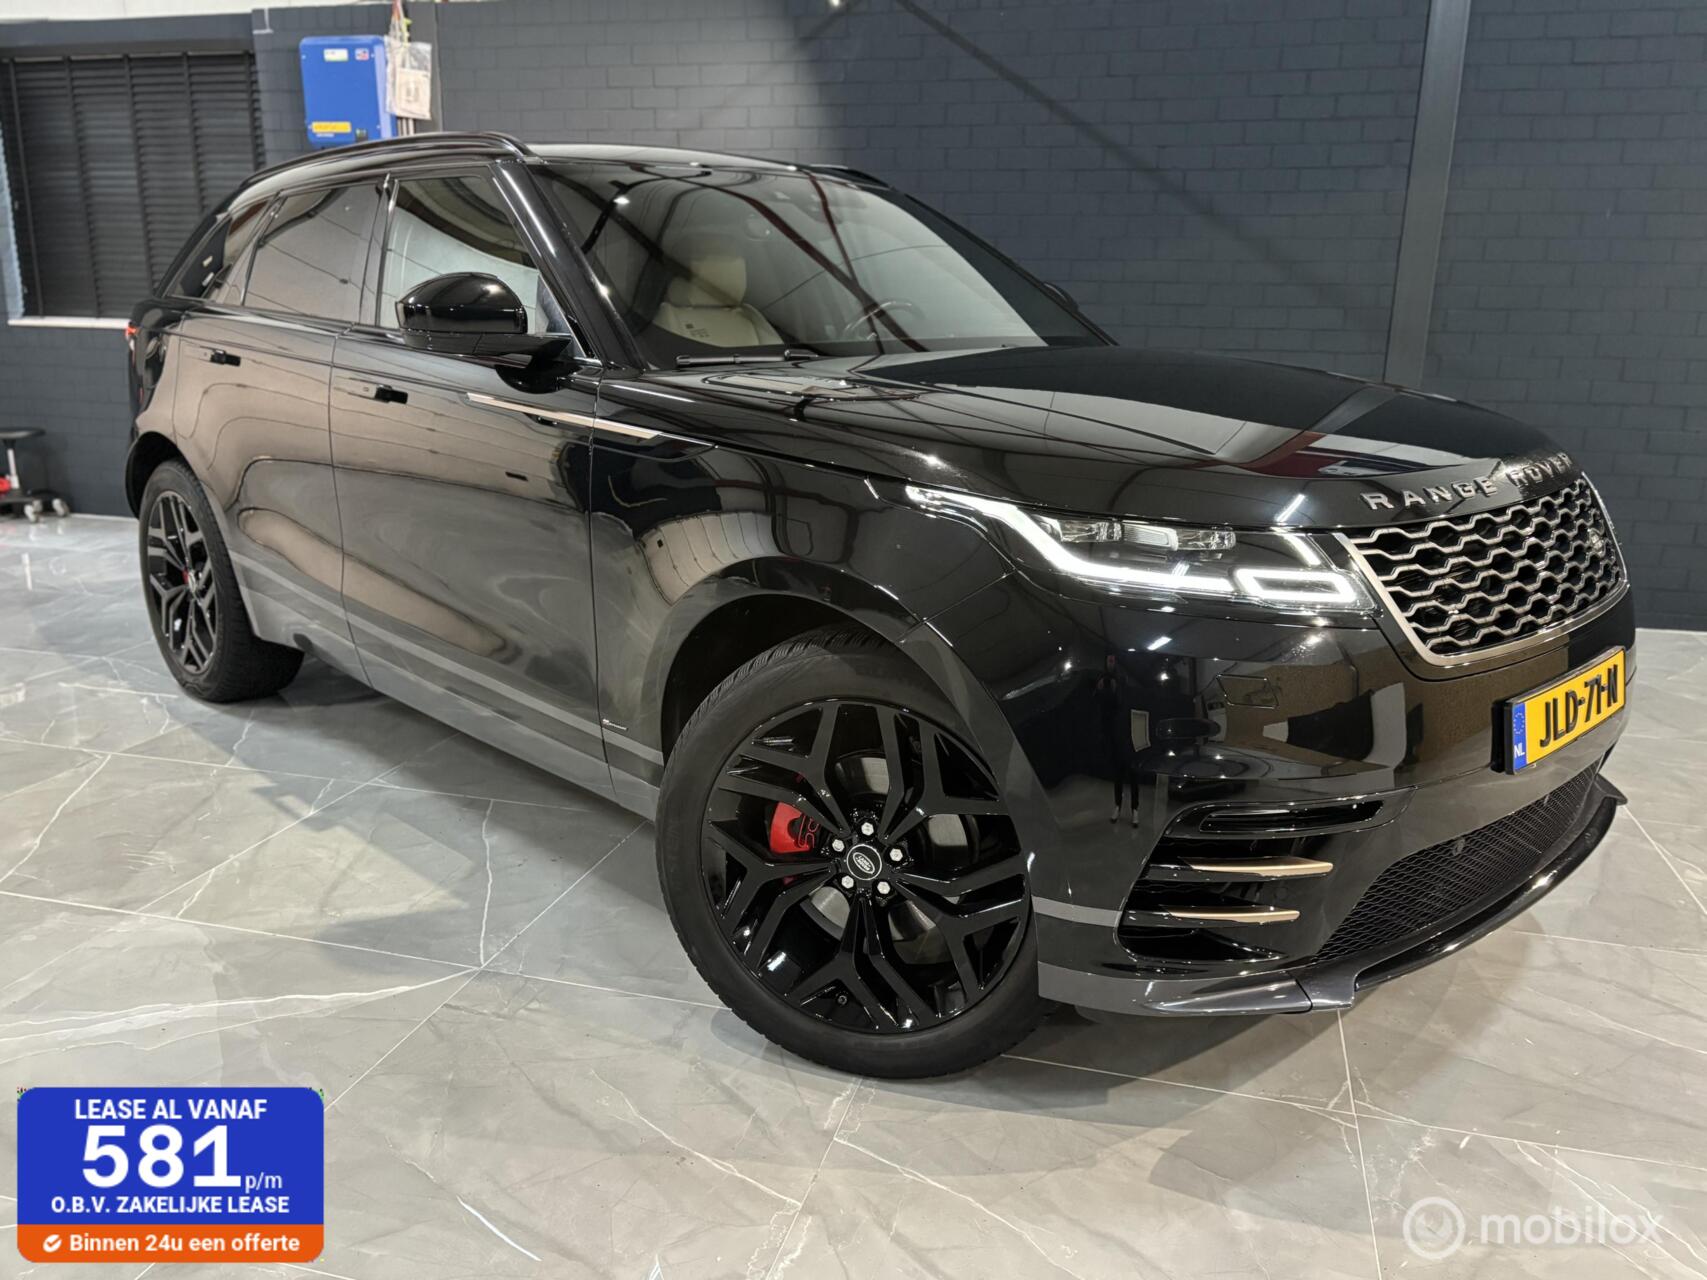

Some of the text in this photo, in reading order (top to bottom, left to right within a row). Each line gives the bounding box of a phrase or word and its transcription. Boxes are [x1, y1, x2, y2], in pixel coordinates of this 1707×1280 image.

[1360, 452, 1574, 511] RANGE ROVER
[1513, 742, 1525, 758] NL
